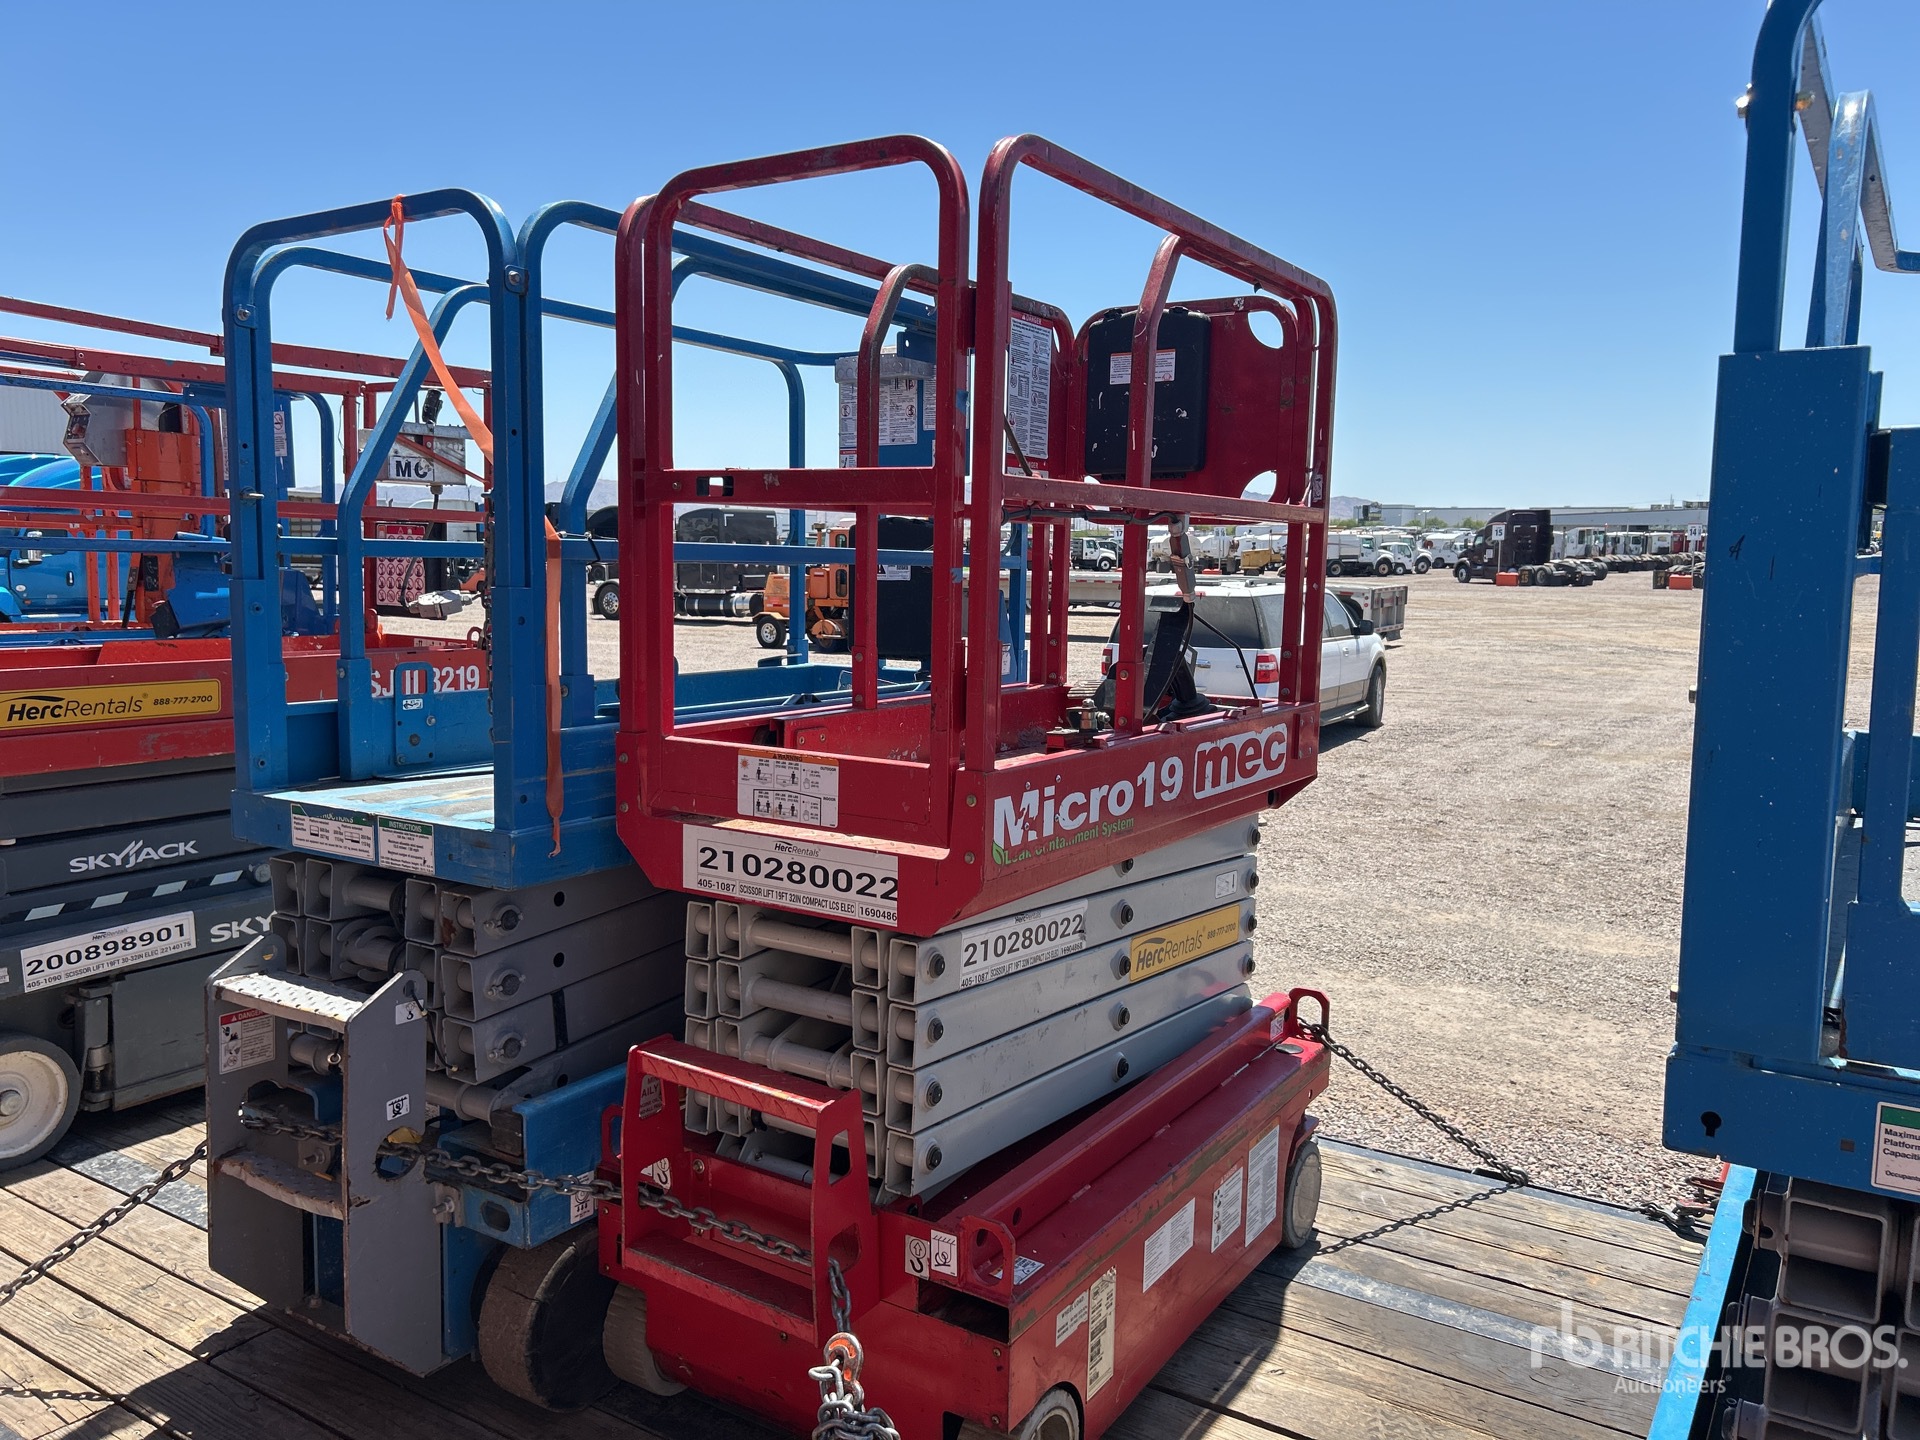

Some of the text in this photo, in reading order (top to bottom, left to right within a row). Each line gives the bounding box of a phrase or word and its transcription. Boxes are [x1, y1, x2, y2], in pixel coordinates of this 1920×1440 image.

[1495, 529, 1503, 537] 15
[1689, 528, 1697, 536] 14
[432, 665, 480, 693] 3219
[7, 694, 213, 722] HercRentals 888-777-2700
[993, 729, 1286, 848] Micro19 mec
[388, 820, 422, 833] INSTRUCTIONS
[1101, 817, 1135, 837] System
[69, 839, 199, 873] SKYJACK
[774, 841, 820, 858] HercRentals
[699, 846, 898, 902] 210280022
[697, 878, 898, 922] 405-1087 SCISSOR LIFT 19FT 32IN COMPACT LCS ELEC 1690486
[26, 923, 185, 977] 200898901
[963, 913, 1085, 968] 210280022
[1135, 922, 1237, 973] HercRentals 888-777-2700
[26, 974, 62, 990] 405-1090
[65, 967, 92, 979] SCISSOR
[92, 963, 105, 972] LIFT
[106, 959, 120, 968] 19FT
[121, 954, 144, 964] 30-32IN
[144, 949, 158, 959] ELEC
[960, 971, 989, 988] 405-1087
[641, 1083, 659, 1098] AILY
[1884, 1127, 1920, 1141] Maximu
[1882, 1147, 1920, 1161] Capaciti
